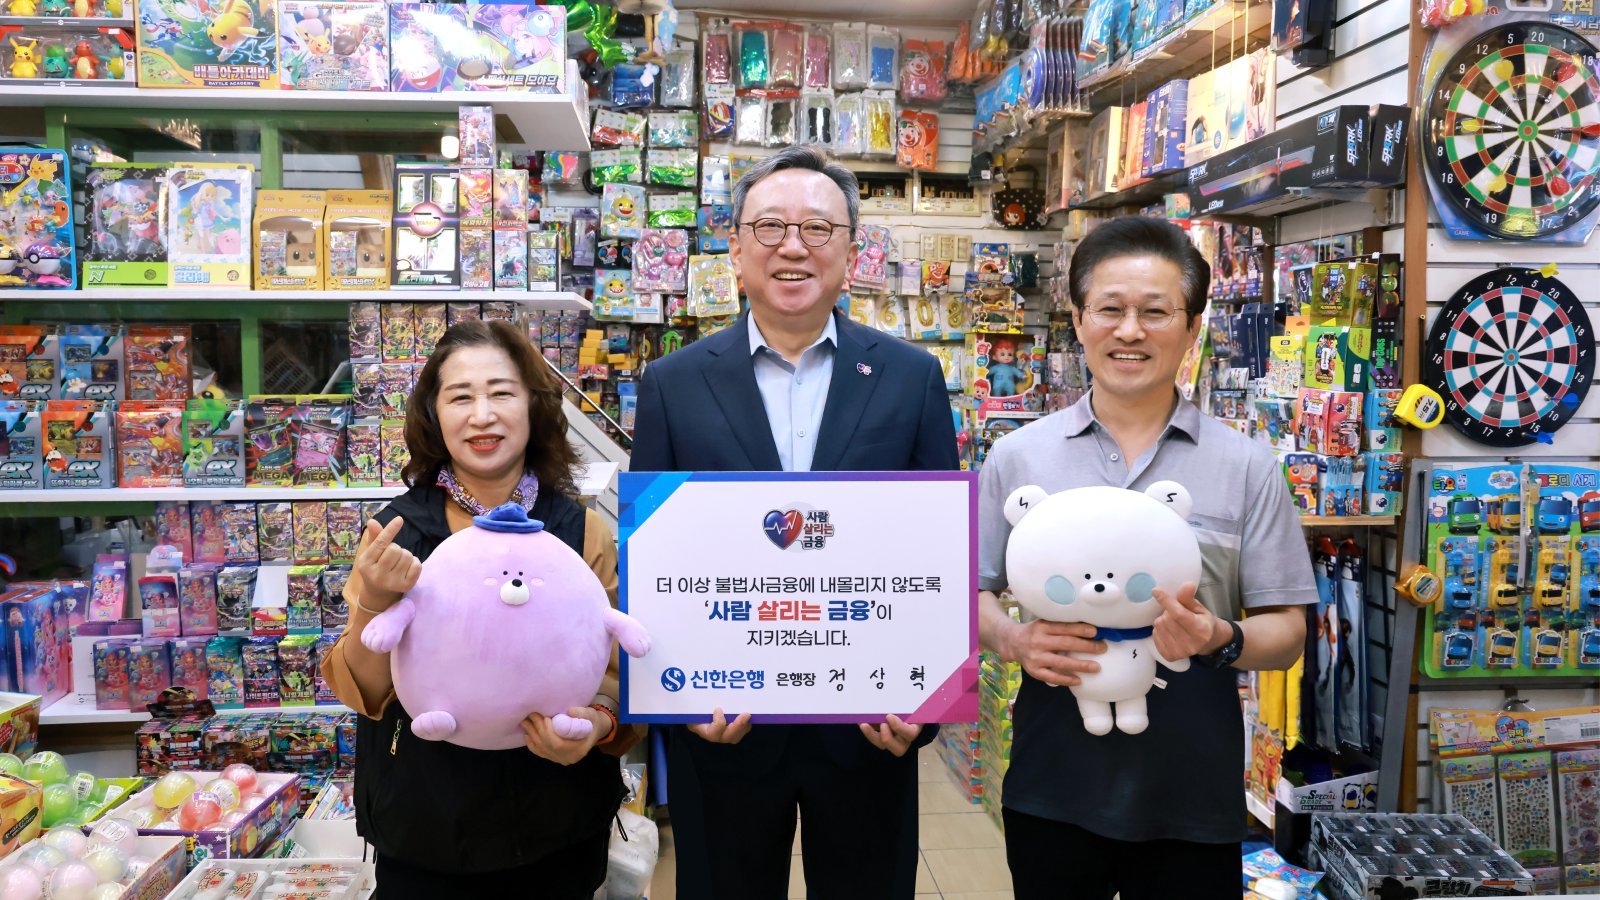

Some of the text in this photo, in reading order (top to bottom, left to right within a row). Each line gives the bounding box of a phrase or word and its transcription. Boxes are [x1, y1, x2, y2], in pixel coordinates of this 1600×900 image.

[1508, 34, 1514, 44] 5
[1532, 32, 1544, 42] 20
[1476, 44, 1488, 54] 12
[1562, 39, 1567, 49] 1
[1582, 55, 1593, 66] 18
[193, 64, 270, 80] 배틀아카데미
[1459, 64, 1466, 74] 9
[1438, 89, 1450, 100] 14
[1346, 124, 1358, 166] SPARK
[1381, 124, 1393, 166] SPARK
[1437, 146, 1444, 157] 8
[1188, 162, 1208, 182] SPARK
[1442, 173, 1454, 184] 16
[1465, 198, 1470, 208] 7
[1568, 206, 1574, 216] 2
[1486, 214, 1498, 224] 19
[1541, 218, 1552, 228] 17
[88, 270, 104, 282] N
[1506, 274, 1517, 285] 12
[1487, 281, 1494, 290] 9
[1531, 280, 1538, 288] 5
[1464, 292, 1472, 302] 14
[1548, 287, 1560, 299] 20
[880, 301, 897, 326] 6
[916, 299, 933, 327] 0
[947, 300, 962, 328] 8
[1567, 305, 1573, 313] 1
[1446, 310, 1457, 321] 11
[1575, 326, 1584, 336] 18
[1439, 333, 1446, 341] 8
[1432, 353, 1442, 364] 16
[1580, 349, 1587, 357] 4
[1574, 372, 1585, 383] 13
[1439, 381, 1445, 389] 7
[20, 384, 51, 400] ex
[84, 384, 116, 400] ex
[1446, 400, 1456, 411] 19
[1549, 410, 1559, 421] 10
[1464, 418, 1470, 426] 3
[1530, 422, 1540, 433] 15
[1482, 427, 1493, 437] 17
[1506, 428, 1513, 437] 2
[0, 462, 34, 479] ex
[67, 461, 100, 478] ex
[205, 460, 236, 476] ex
[253, 472, 290, 480] MEGA
[300, 472, 337, 480] MEGA
[1573, 474, 1596, 487] 시계
[1433, 477, 1456, 490] 타요
[806, 512, 828, 523] 사람
[804, 523, 833, 535] 살리는
[803, 536, 824, 548] 금융
[657, 577, 941, 593] 더 이상 불법사금융에 내몰리지 않도록
[758, 600, 821, 621] 살리는
[747, 630, 850, 646] 지키겠습니다.
[690, 666, 925, 691] 신한은행 은행장 정 상 혁
